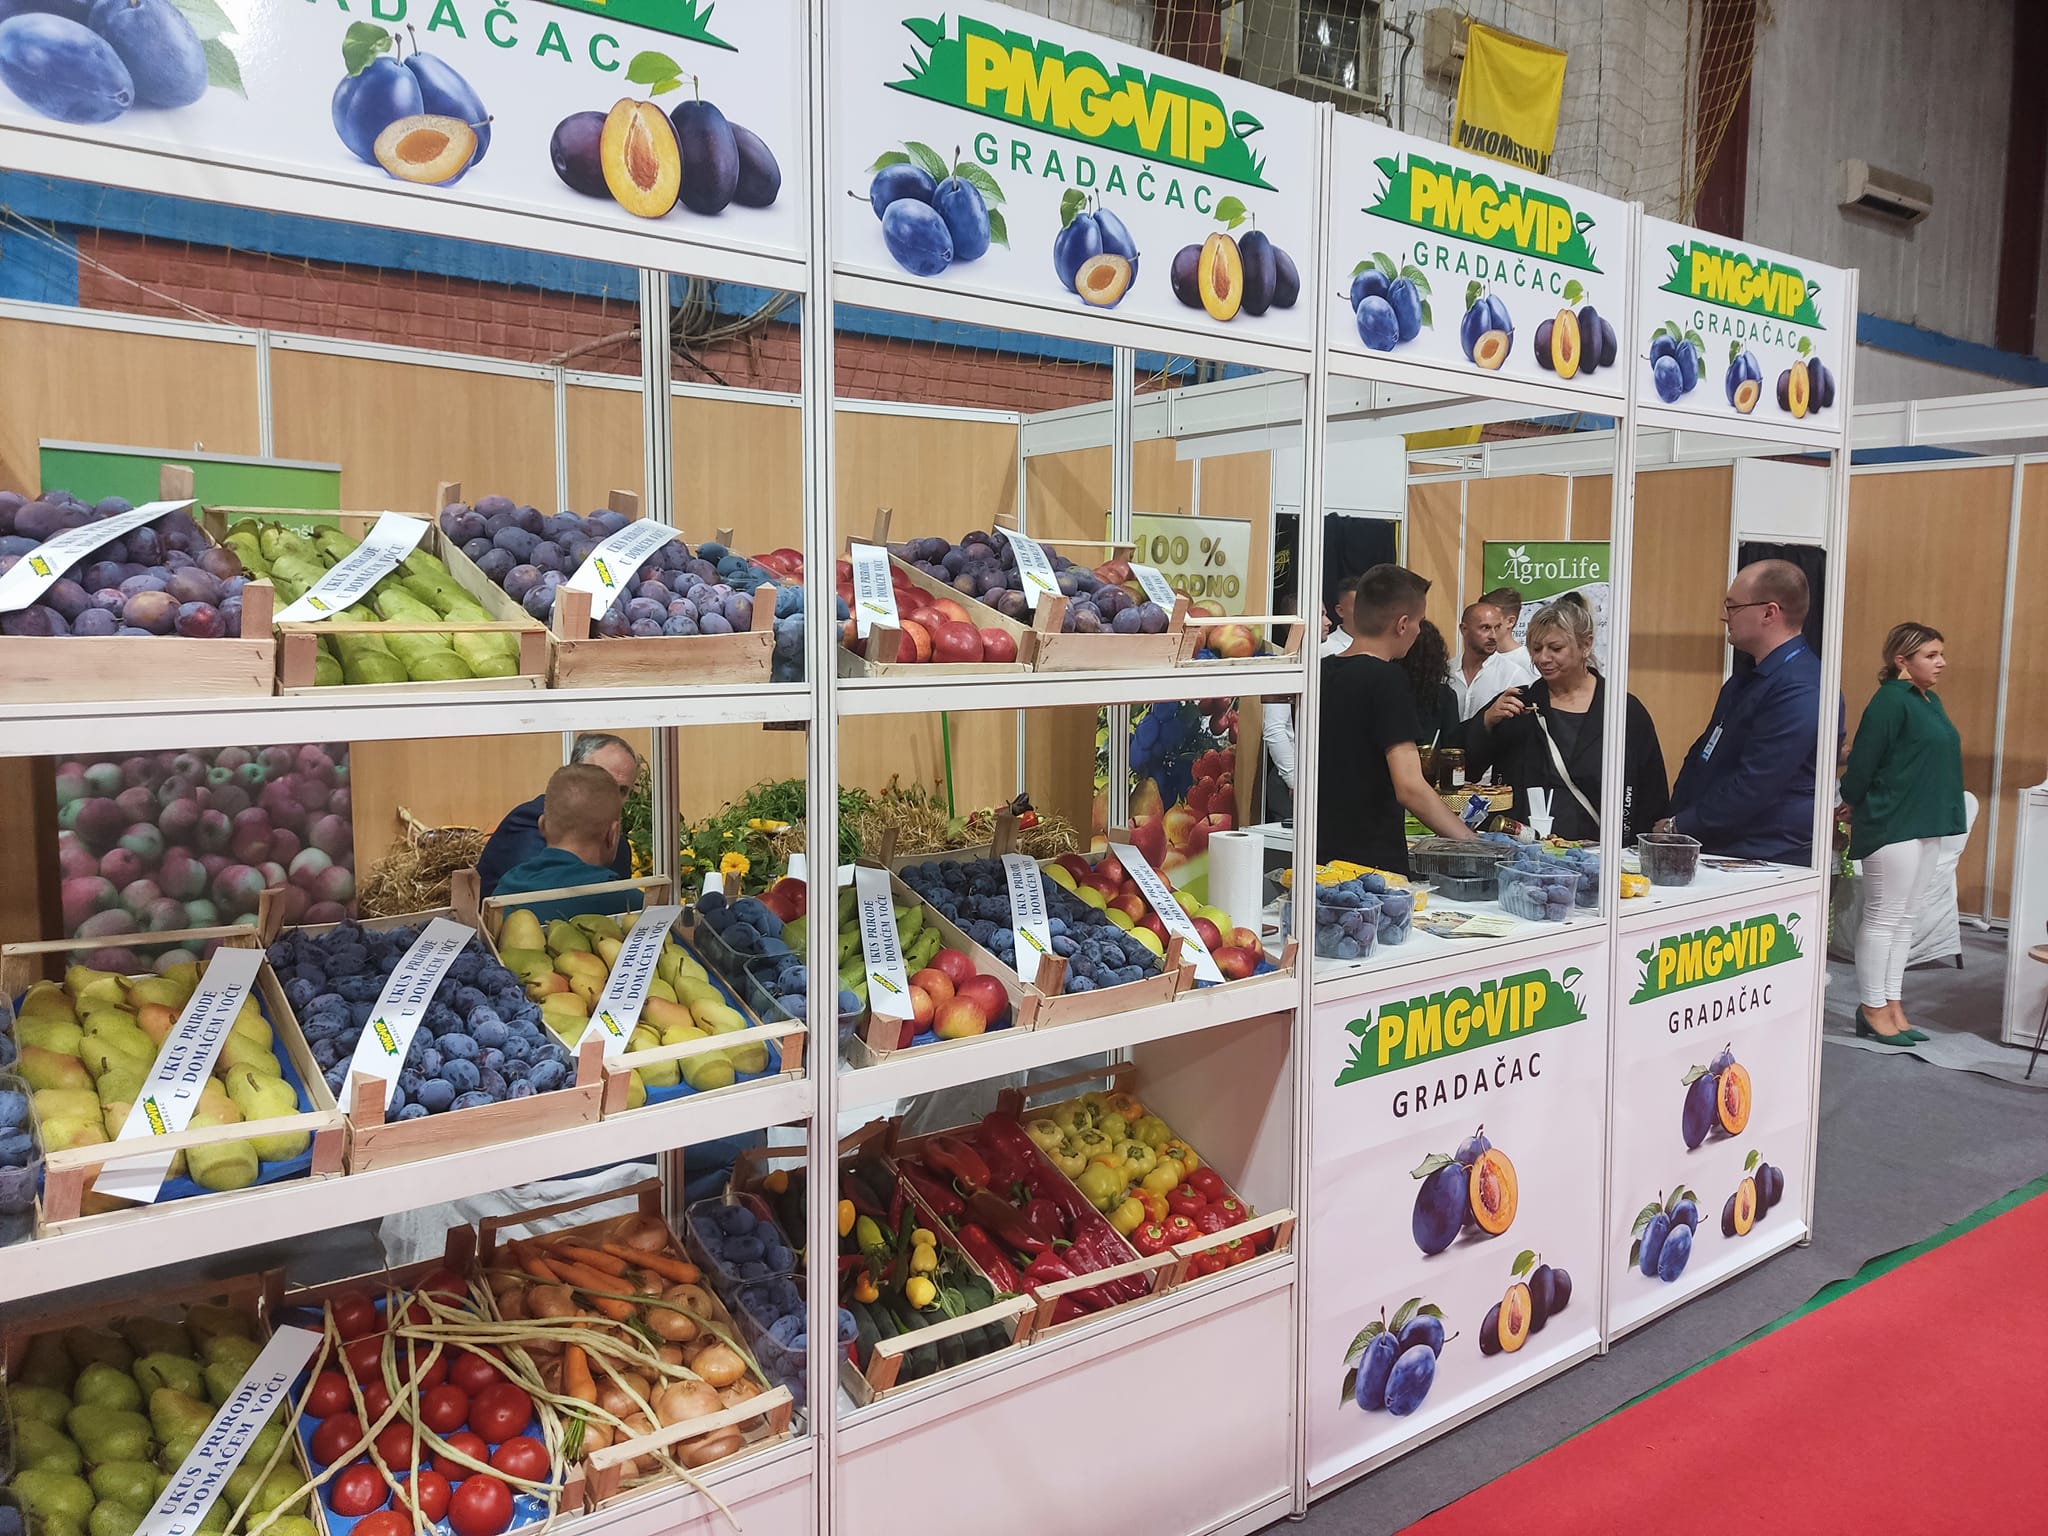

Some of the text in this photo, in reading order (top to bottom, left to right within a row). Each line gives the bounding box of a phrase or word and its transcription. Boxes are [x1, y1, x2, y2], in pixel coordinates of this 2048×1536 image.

[973, 132, 1212, 214] GRADAČAC
[1413, 241, 1562, 294] GRADAČAC
[1694, 311, 1797, 348] GRADAČAC
[1134, 534, 1226, 567] 100 %
[1498, 556, 1600, 584] AgroLife
[863, 901, 881, 964] UKUS PRIRODE
[877, 894, 889, 918] VOĆU
[609, 972, 630, 1001] UKUS
[622, 926, 650, 969] PRIRODE
[881, 920, 896, 962] DOMAĆEM
[387, 973, 413, 1004] UKUS
[407, 939, 439, 971] PRIRODE
[408, 957, 446, 1004] DOMAĆEM
[627, 943, 657, 999] DOMAĆEM
[402, 1008, 415, 1017] U
[623, 1003, 635, 1011] U
[1669, 984, 1772, 1034] GRADAČAC
[158, 990, 218, 1081] UKUS PRIRODE
[174, 983, 242, 1099] U DOMAĆEM VOĆU
[1393, 1052, 1542, 1119] GRADAČAC
[159, 1380, 261, 1515] UKUS PRIRODE
[168, 1372, 288, 1535] U DOMAĆEM VOĆU
